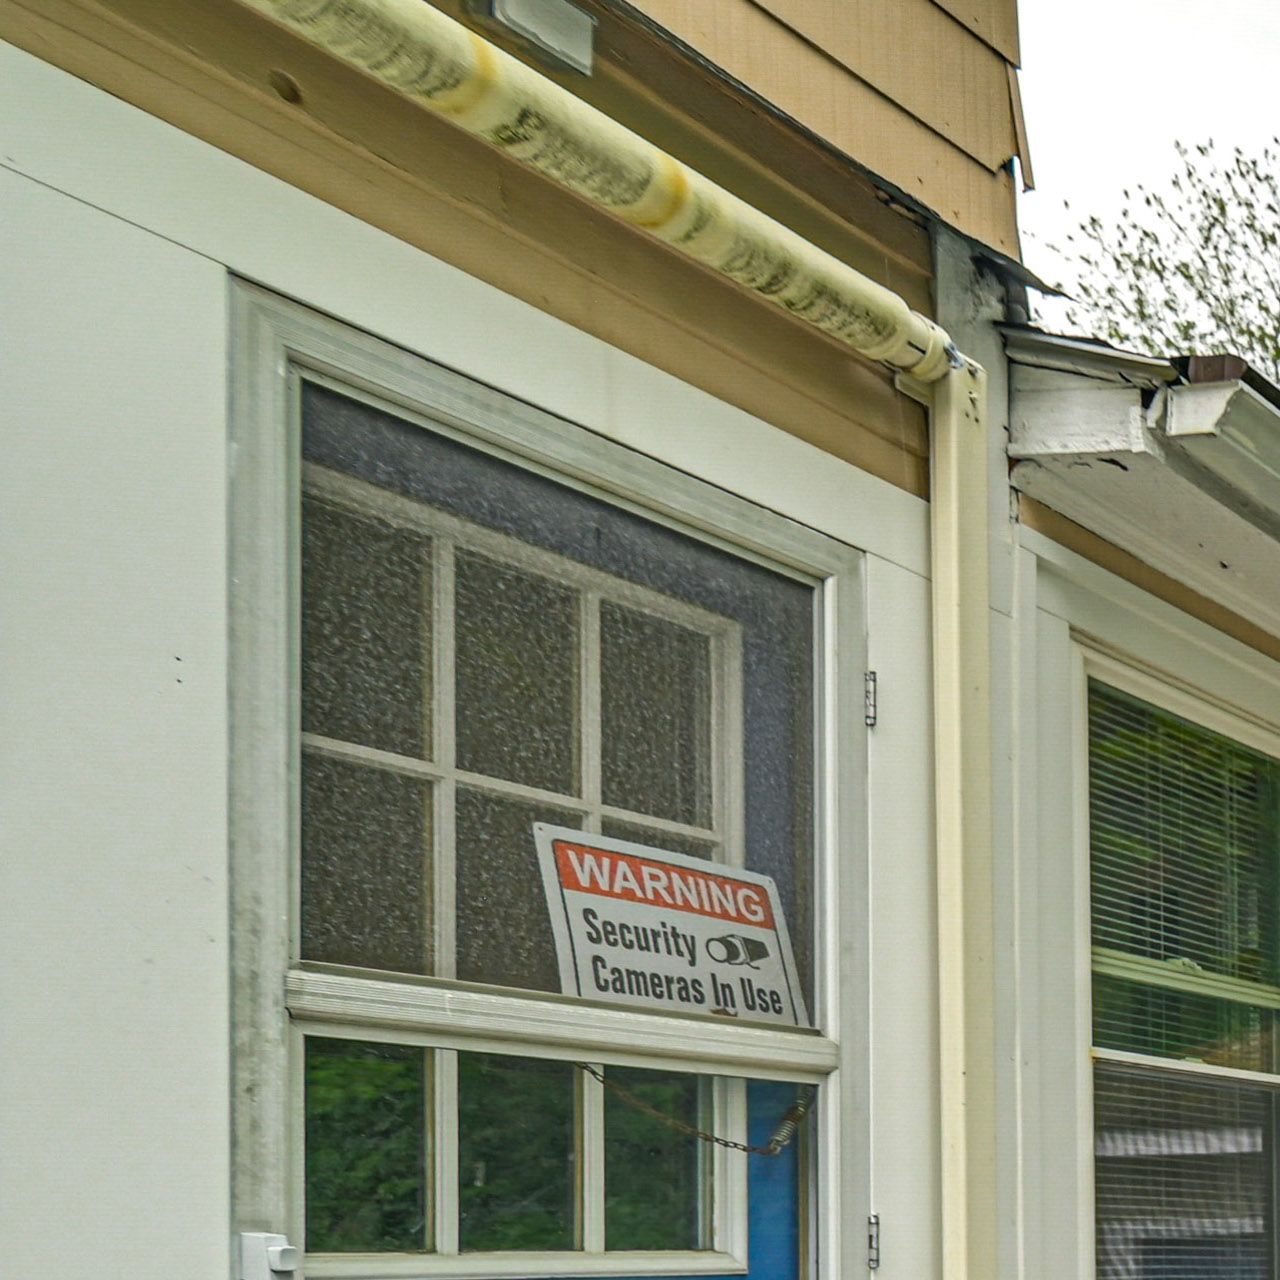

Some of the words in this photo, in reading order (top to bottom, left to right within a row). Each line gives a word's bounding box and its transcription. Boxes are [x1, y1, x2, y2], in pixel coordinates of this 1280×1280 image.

[567, 850, 765, 922] WARNING
[582, 907, 697, 967] Security
[591, 955, 705, 1005] Cameras
[710, 973, 737, 1008] In
[740, 977, 783, 1015] Use
